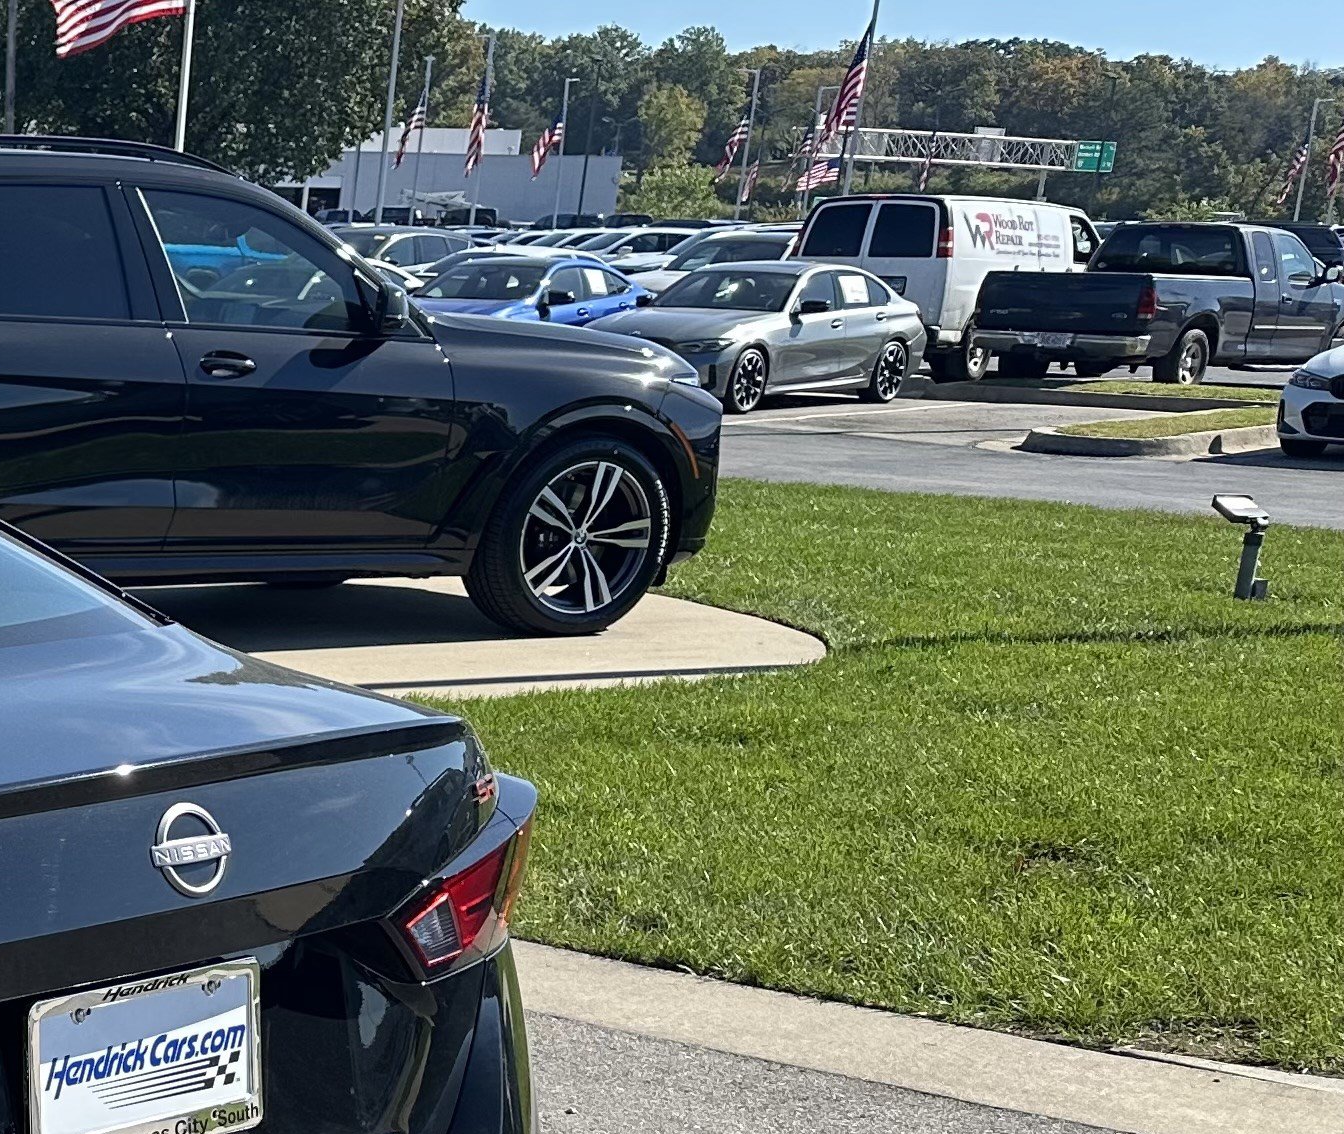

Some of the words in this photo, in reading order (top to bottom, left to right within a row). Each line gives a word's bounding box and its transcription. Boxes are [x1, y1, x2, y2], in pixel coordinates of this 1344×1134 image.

[154, 836, 232, 864] NISSAN
[101, 973, 190, 1002] Hendrick
[217, 1102, 259, 1127] South
